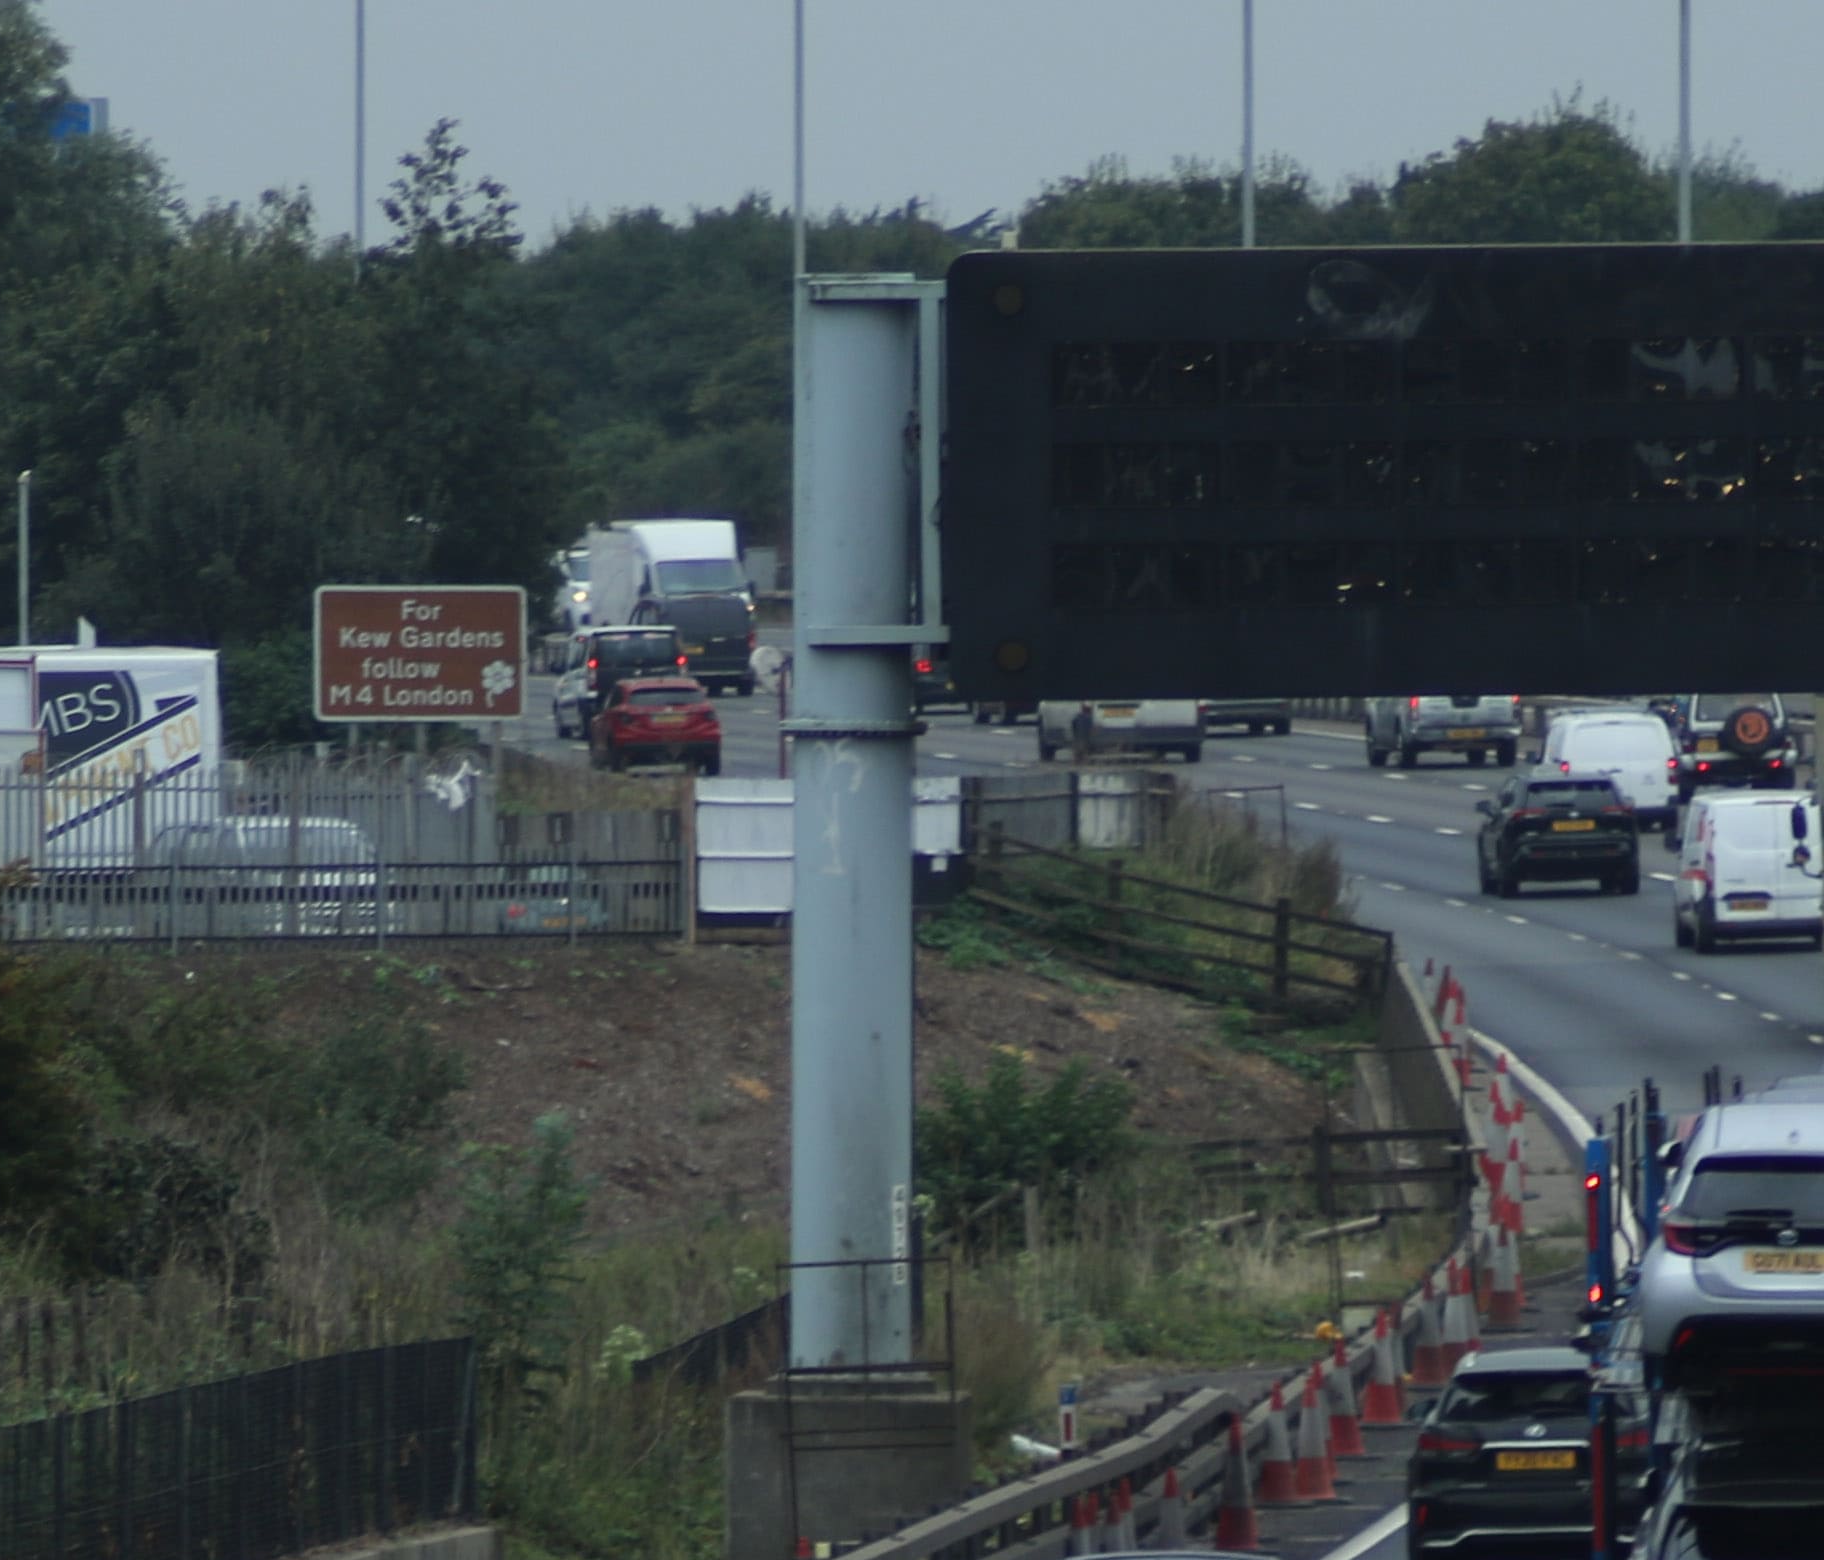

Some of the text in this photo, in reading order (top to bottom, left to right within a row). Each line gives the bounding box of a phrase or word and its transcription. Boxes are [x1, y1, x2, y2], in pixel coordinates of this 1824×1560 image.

[400, 599, 443, 621] For
[339, 626, 506, 649] Kew Gardens
[362, 658, 442, 679] follow
[383, 684, 475, 707] London
